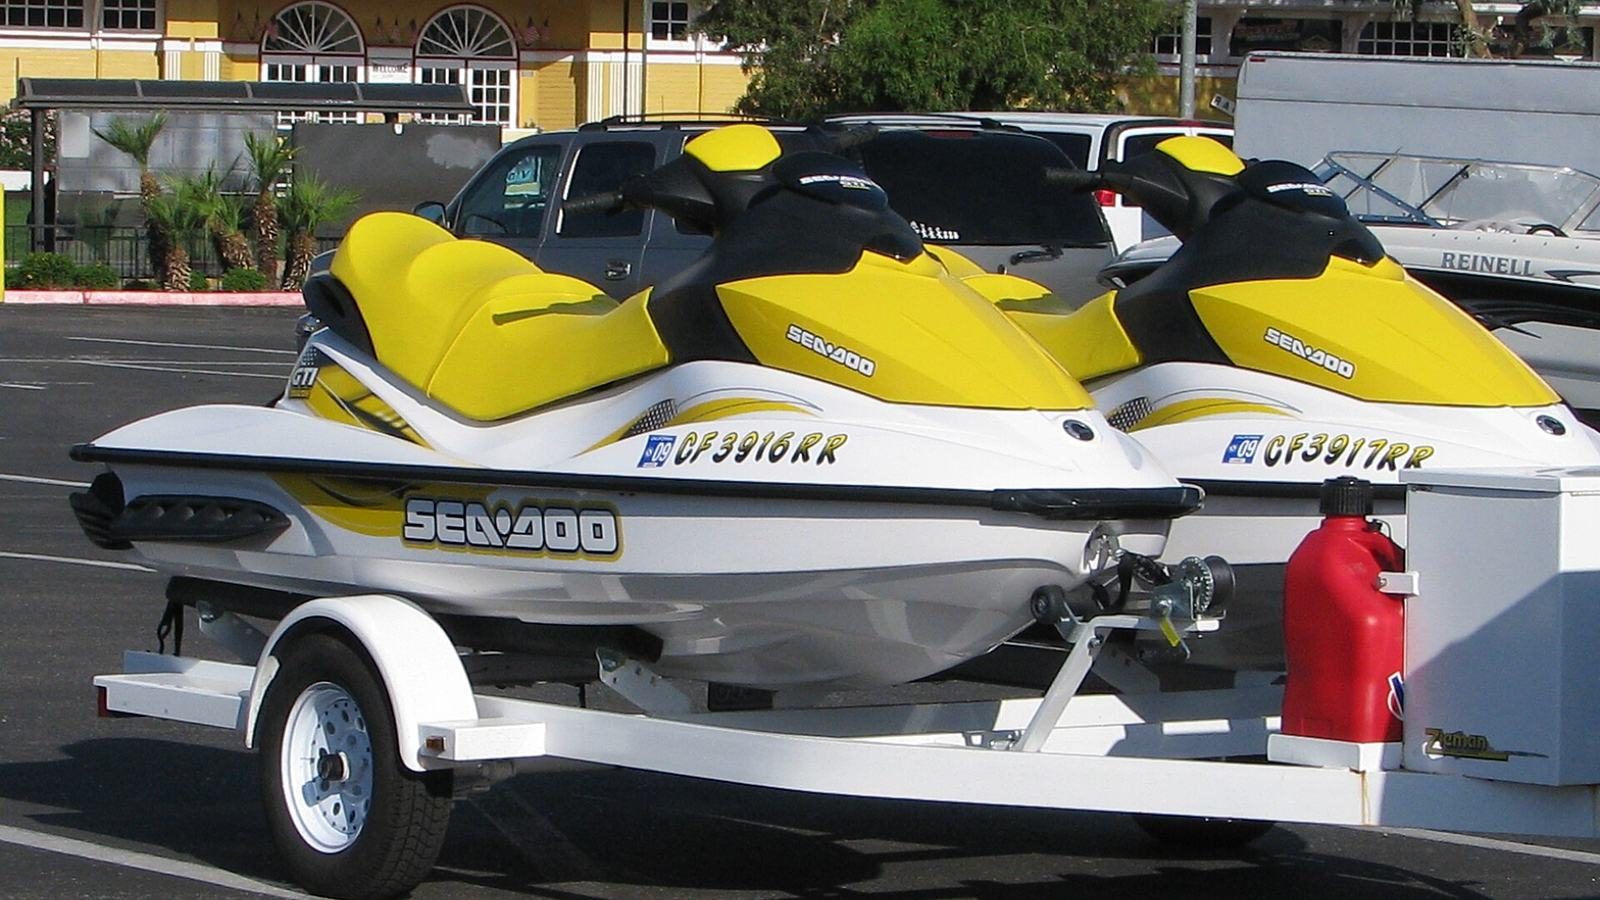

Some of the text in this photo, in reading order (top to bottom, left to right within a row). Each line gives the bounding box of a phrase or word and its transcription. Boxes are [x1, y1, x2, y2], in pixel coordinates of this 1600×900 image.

[1441, 252, 1535, 276] REINELL
[292, 367, 318, 386] GTI
[652, 442, 672, 462] 09
[1237, 439, 1258, 458] 09
[1425, 728, 1488, 755] Zieman
